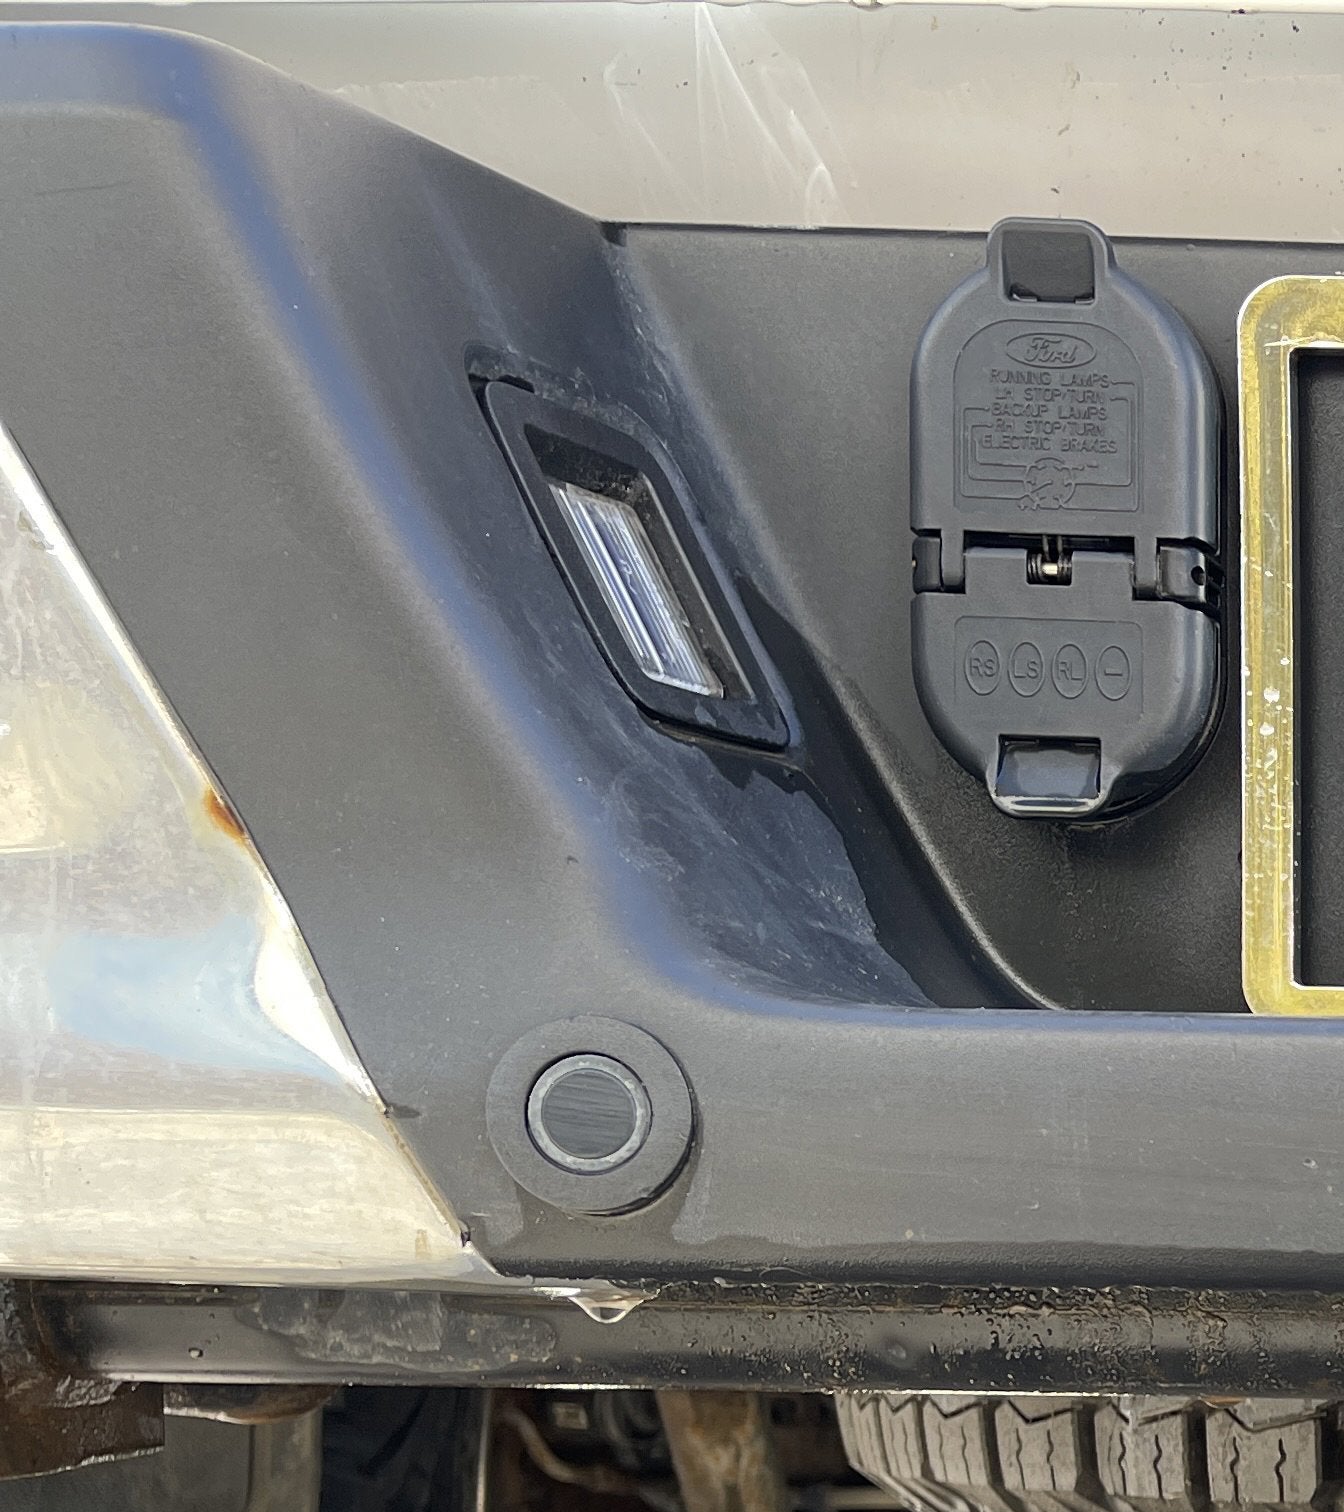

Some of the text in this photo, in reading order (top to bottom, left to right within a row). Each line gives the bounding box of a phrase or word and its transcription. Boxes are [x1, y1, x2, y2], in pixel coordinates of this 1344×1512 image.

[1024, 336, 1079, 365] Ford
[989, 368, 1111, 389] RUNNING LAMPS
[1023, 387, 1106, 405] STOP/TURN
[991, 402, 1108, 421] BACKUP LAMPS
[1023, 419, 1106, 437] STOP/TURN
[981, 434, 1118, 454] ELECTRIC BRAKES
[968, 656, 997, 678] RS
[1012, 658, 1040, 679] LS
[1055, 660, 1084, 681] RL
